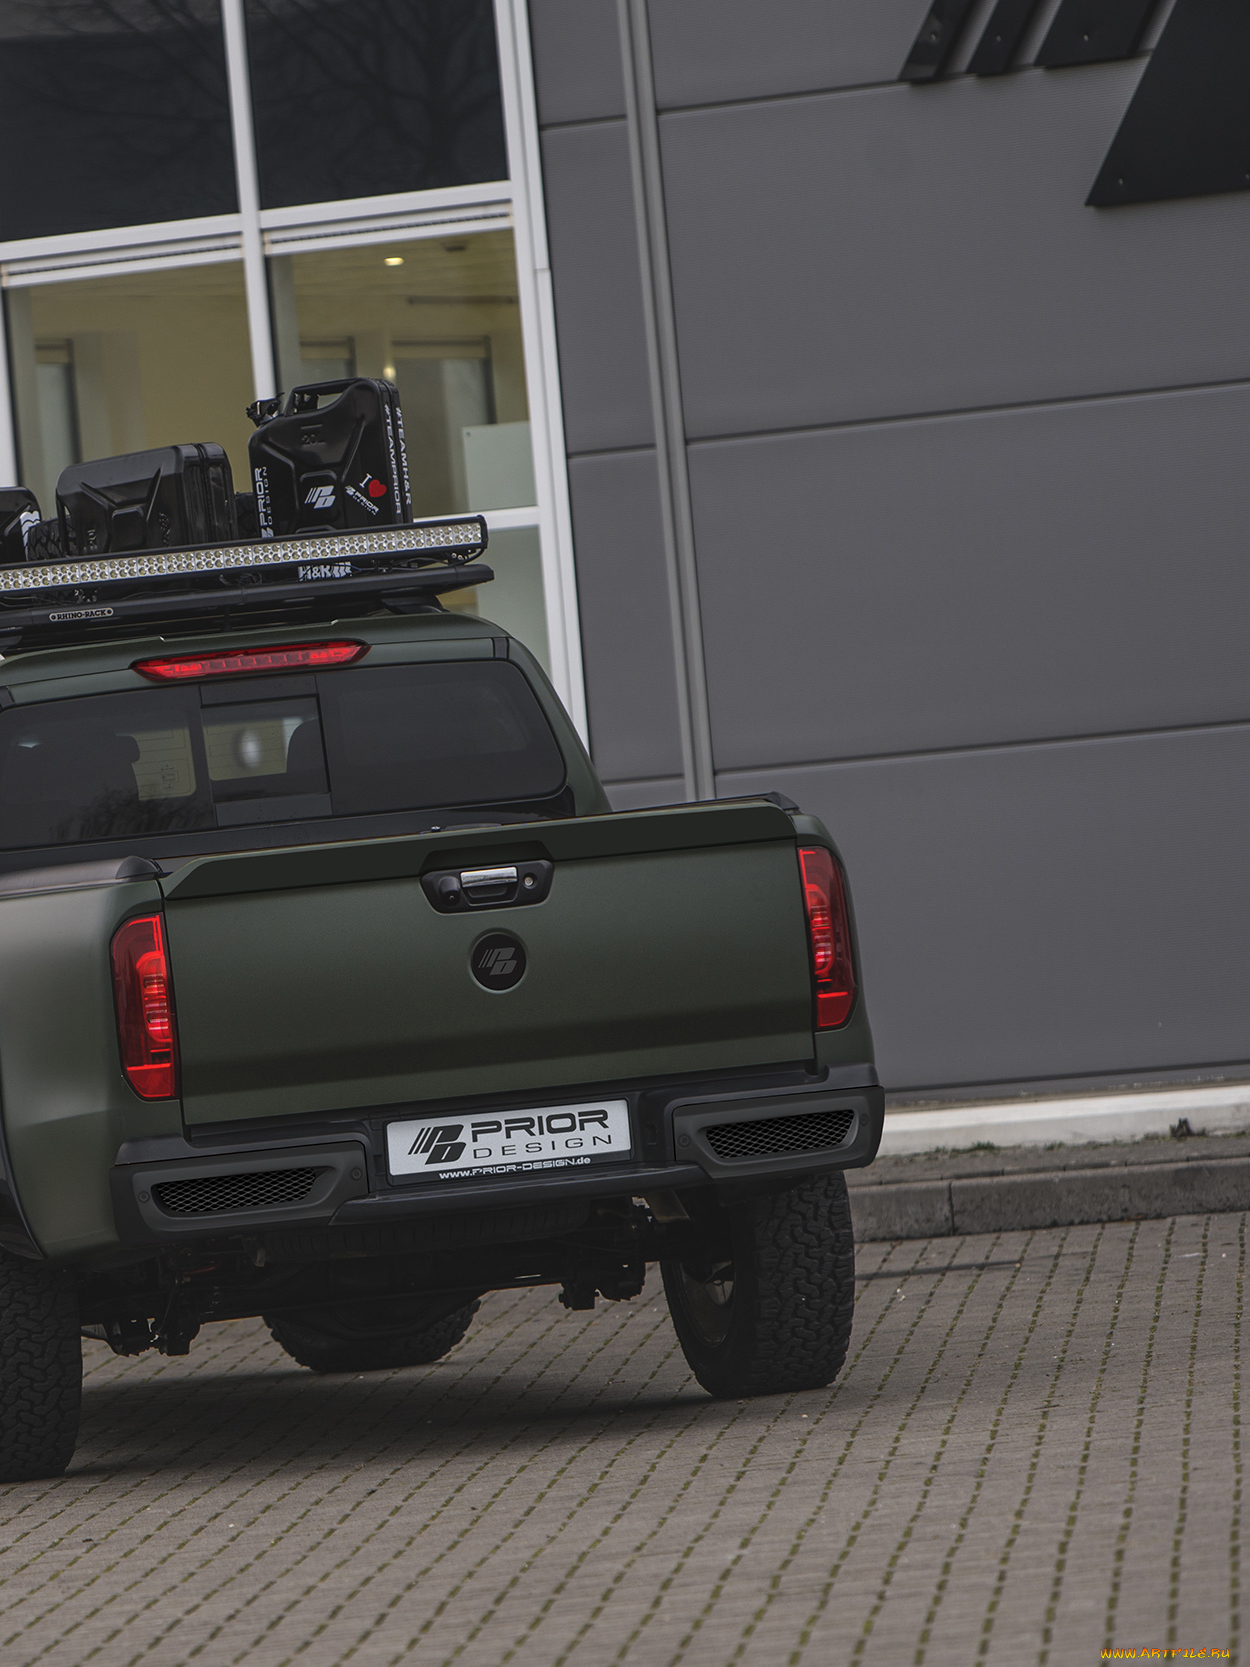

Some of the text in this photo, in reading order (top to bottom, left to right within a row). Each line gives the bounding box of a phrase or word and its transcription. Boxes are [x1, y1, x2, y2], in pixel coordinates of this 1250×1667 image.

[254, 467, 268, 527] PRIOR
[262, 466, 273, 525] DESIGN
[354, 491, 380, 514] PRIOR
[57, 609, 107, 621] RHINO-RACK
[471, 1109, 609, 1143] PRIOR
[473, 1135, 612, 1159] DESIGN
